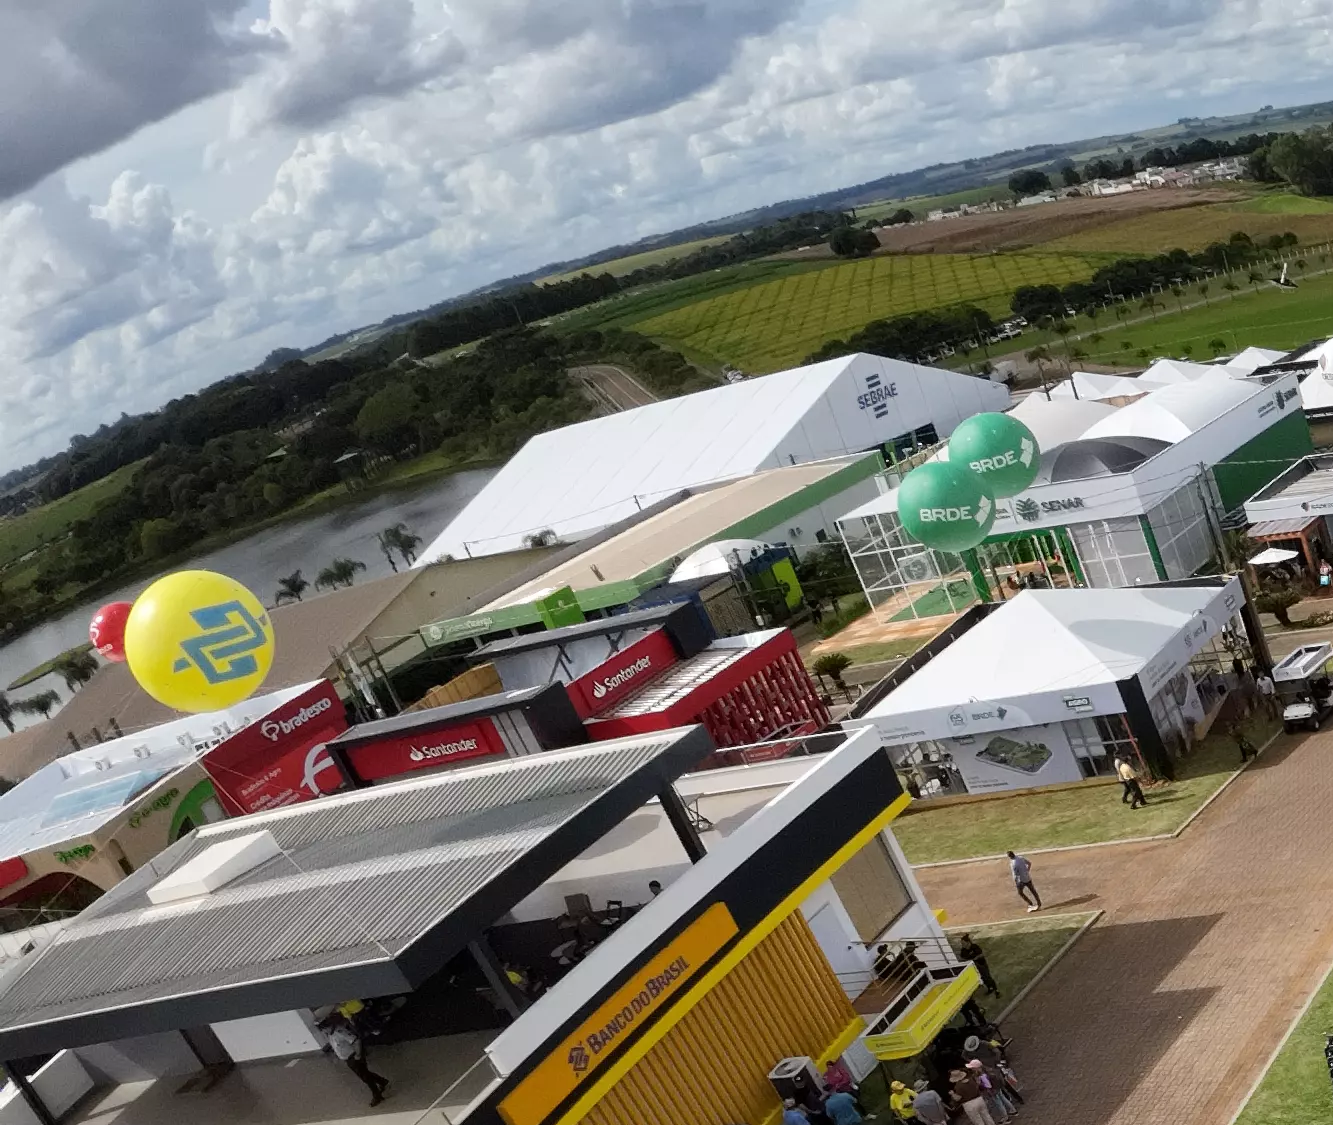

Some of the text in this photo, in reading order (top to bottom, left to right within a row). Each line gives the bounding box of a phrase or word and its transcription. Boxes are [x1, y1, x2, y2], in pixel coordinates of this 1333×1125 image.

[857, 382, 899, 410] SEBRAE
[919, 505, 972, 523] BRDE
[1041, 496, 1085, 514] SENAR
[604, 655, 652, 692] Santander
[280, 697, 332, 735] bradesco
[421, 737, 479, 759] Santander
[586, 955, 691, 1055] BANCO DO BRASIL
